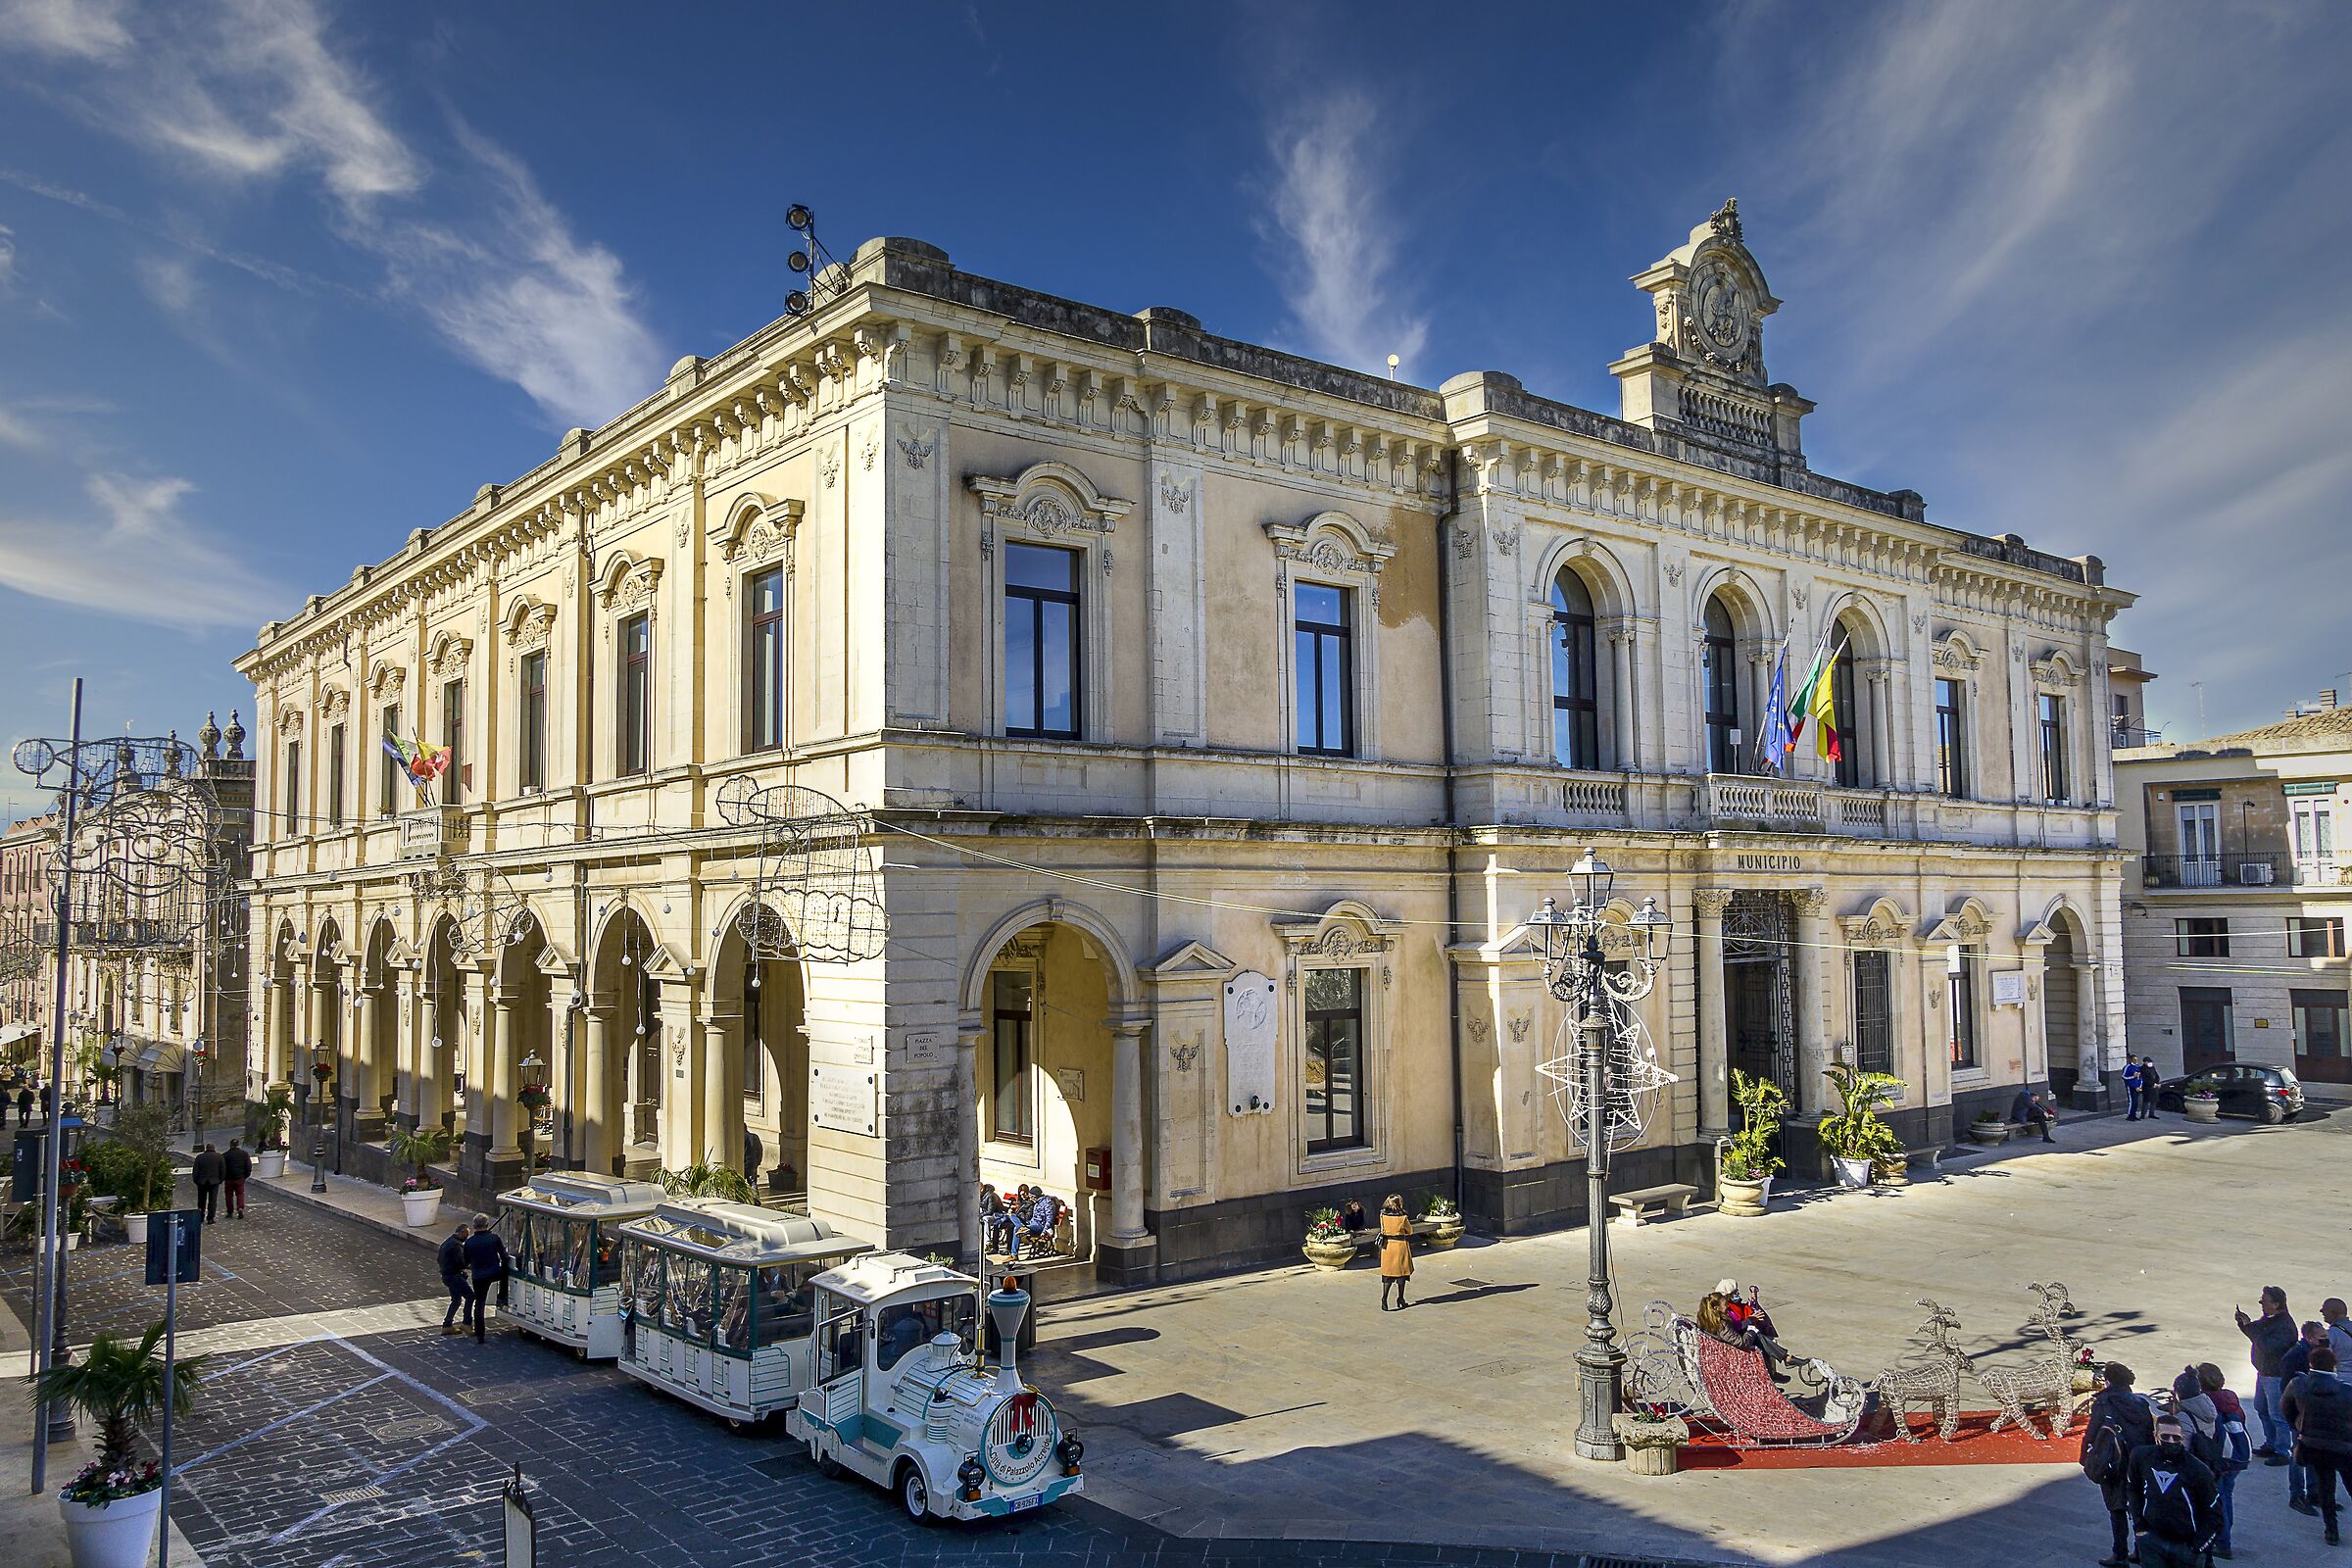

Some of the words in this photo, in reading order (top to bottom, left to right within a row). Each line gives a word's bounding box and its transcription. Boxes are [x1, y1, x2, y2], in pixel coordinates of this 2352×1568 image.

[1738, 855, 1800, 869] MUNICIPIO
[990, 1452, 1001, 1469] Città
[1000, 1465, 1006, 1474] di
[1006, 1462, 1035, 1476] Palazzolo
[1034, 1438, 1052, 1465] Acreide
